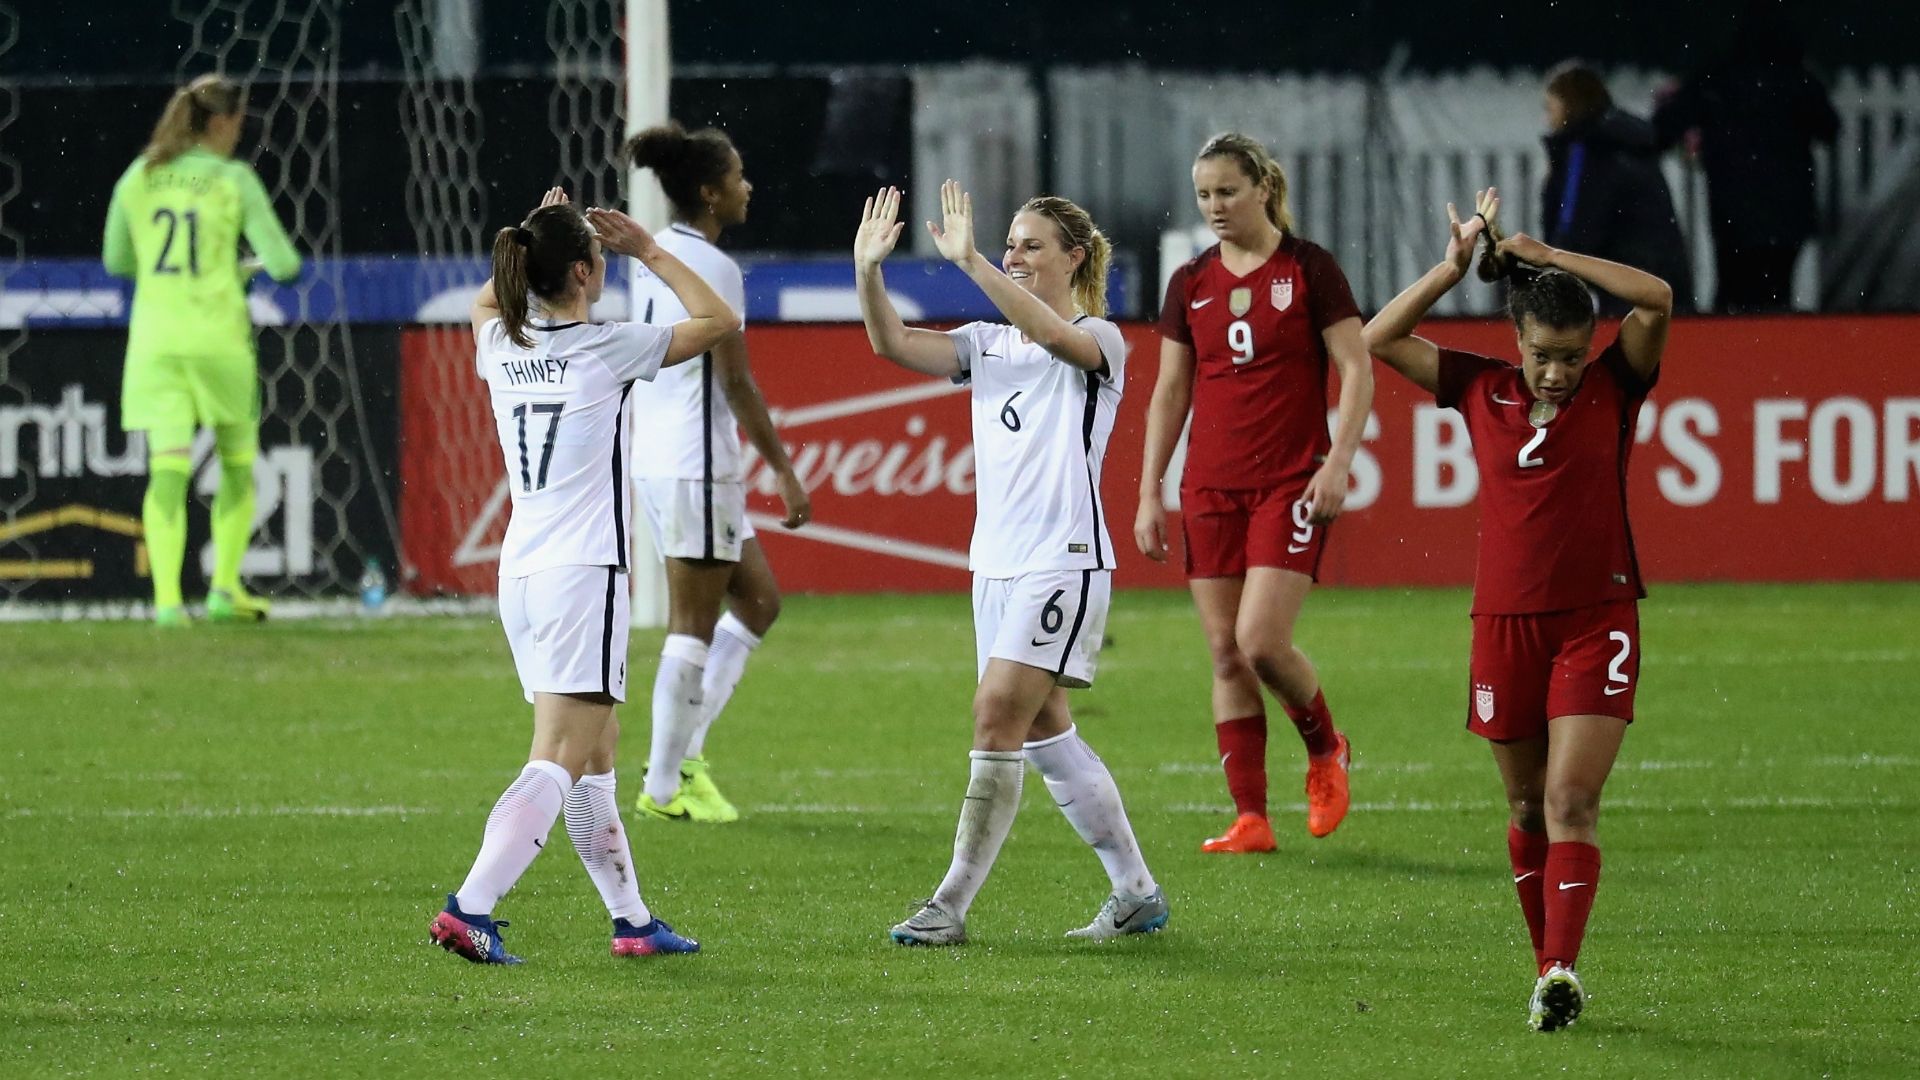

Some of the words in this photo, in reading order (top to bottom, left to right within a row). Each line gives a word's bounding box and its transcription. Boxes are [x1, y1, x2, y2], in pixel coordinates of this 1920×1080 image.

[153, 208, 199, 277] 21
[1228, 320, 1254, 365] 9
[502, 359, 569, 386] THINEY
[1000, 391, 1023, 432] 6
[512, 401, 566, 493] 17
[1517, 428, 1548, 468] 2
[1292, 499, 1314, 544] 9
[1041, 589, 1066, 634] 6
[1608, 631, 1630, 683] 2
